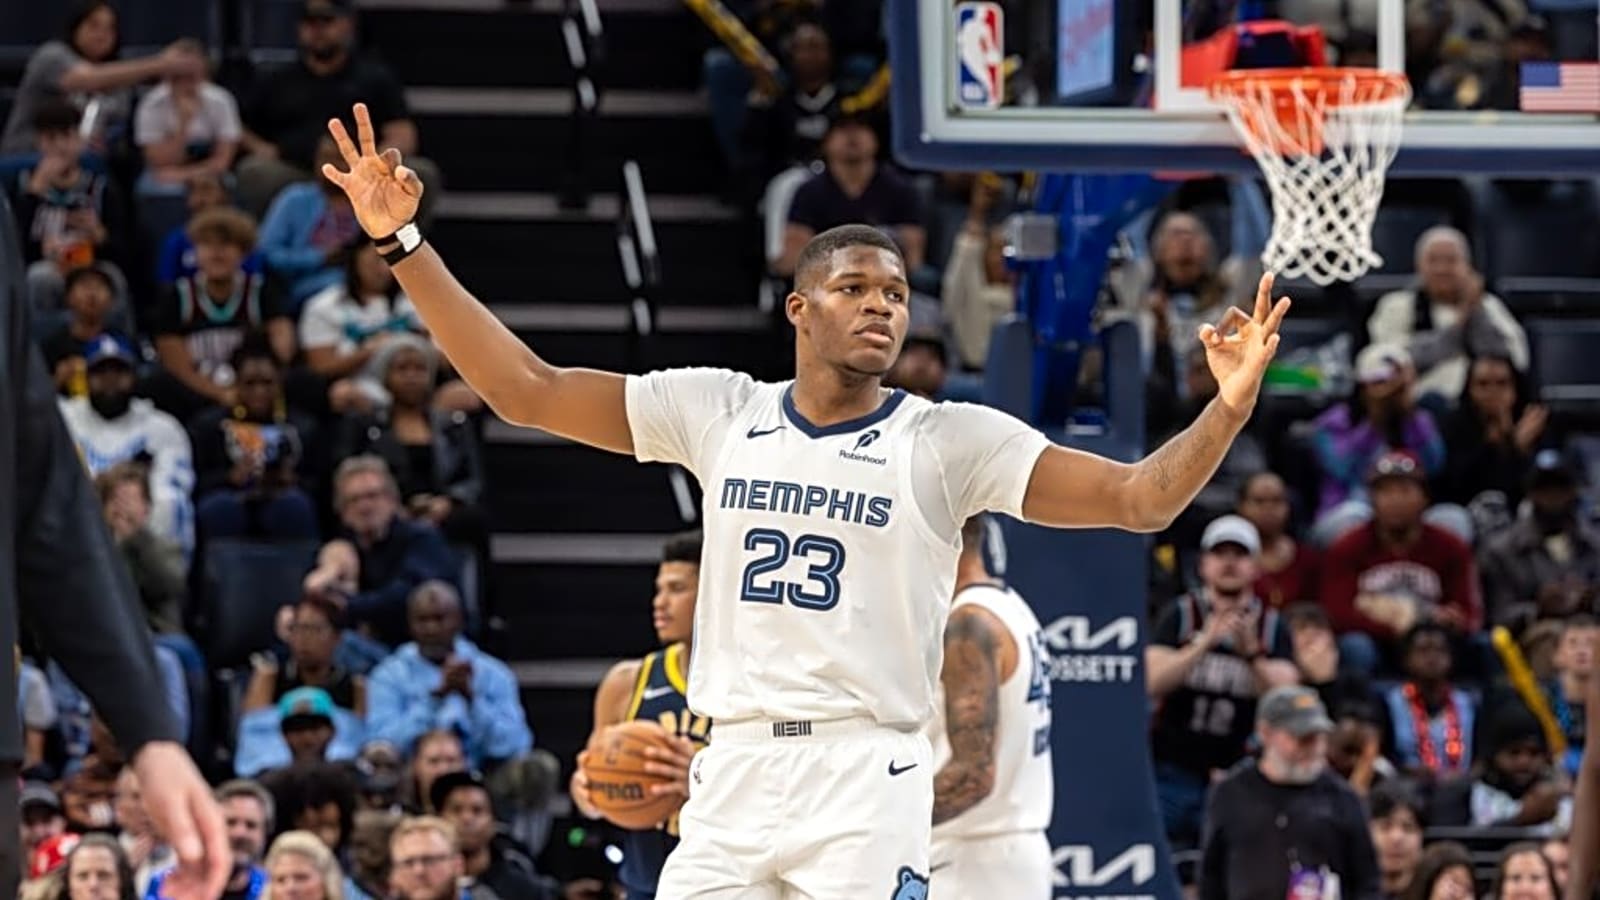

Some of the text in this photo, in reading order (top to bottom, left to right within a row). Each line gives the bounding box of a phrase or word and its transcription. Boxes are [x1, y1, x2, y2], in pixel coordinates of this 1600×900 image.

[839, 449, 886, 465] Robinhood
[720, 478, 892, 527] MEMPHIS
[740, 527, 846, 611] 23
[1048, 655, 1137, 682] OSSETT
